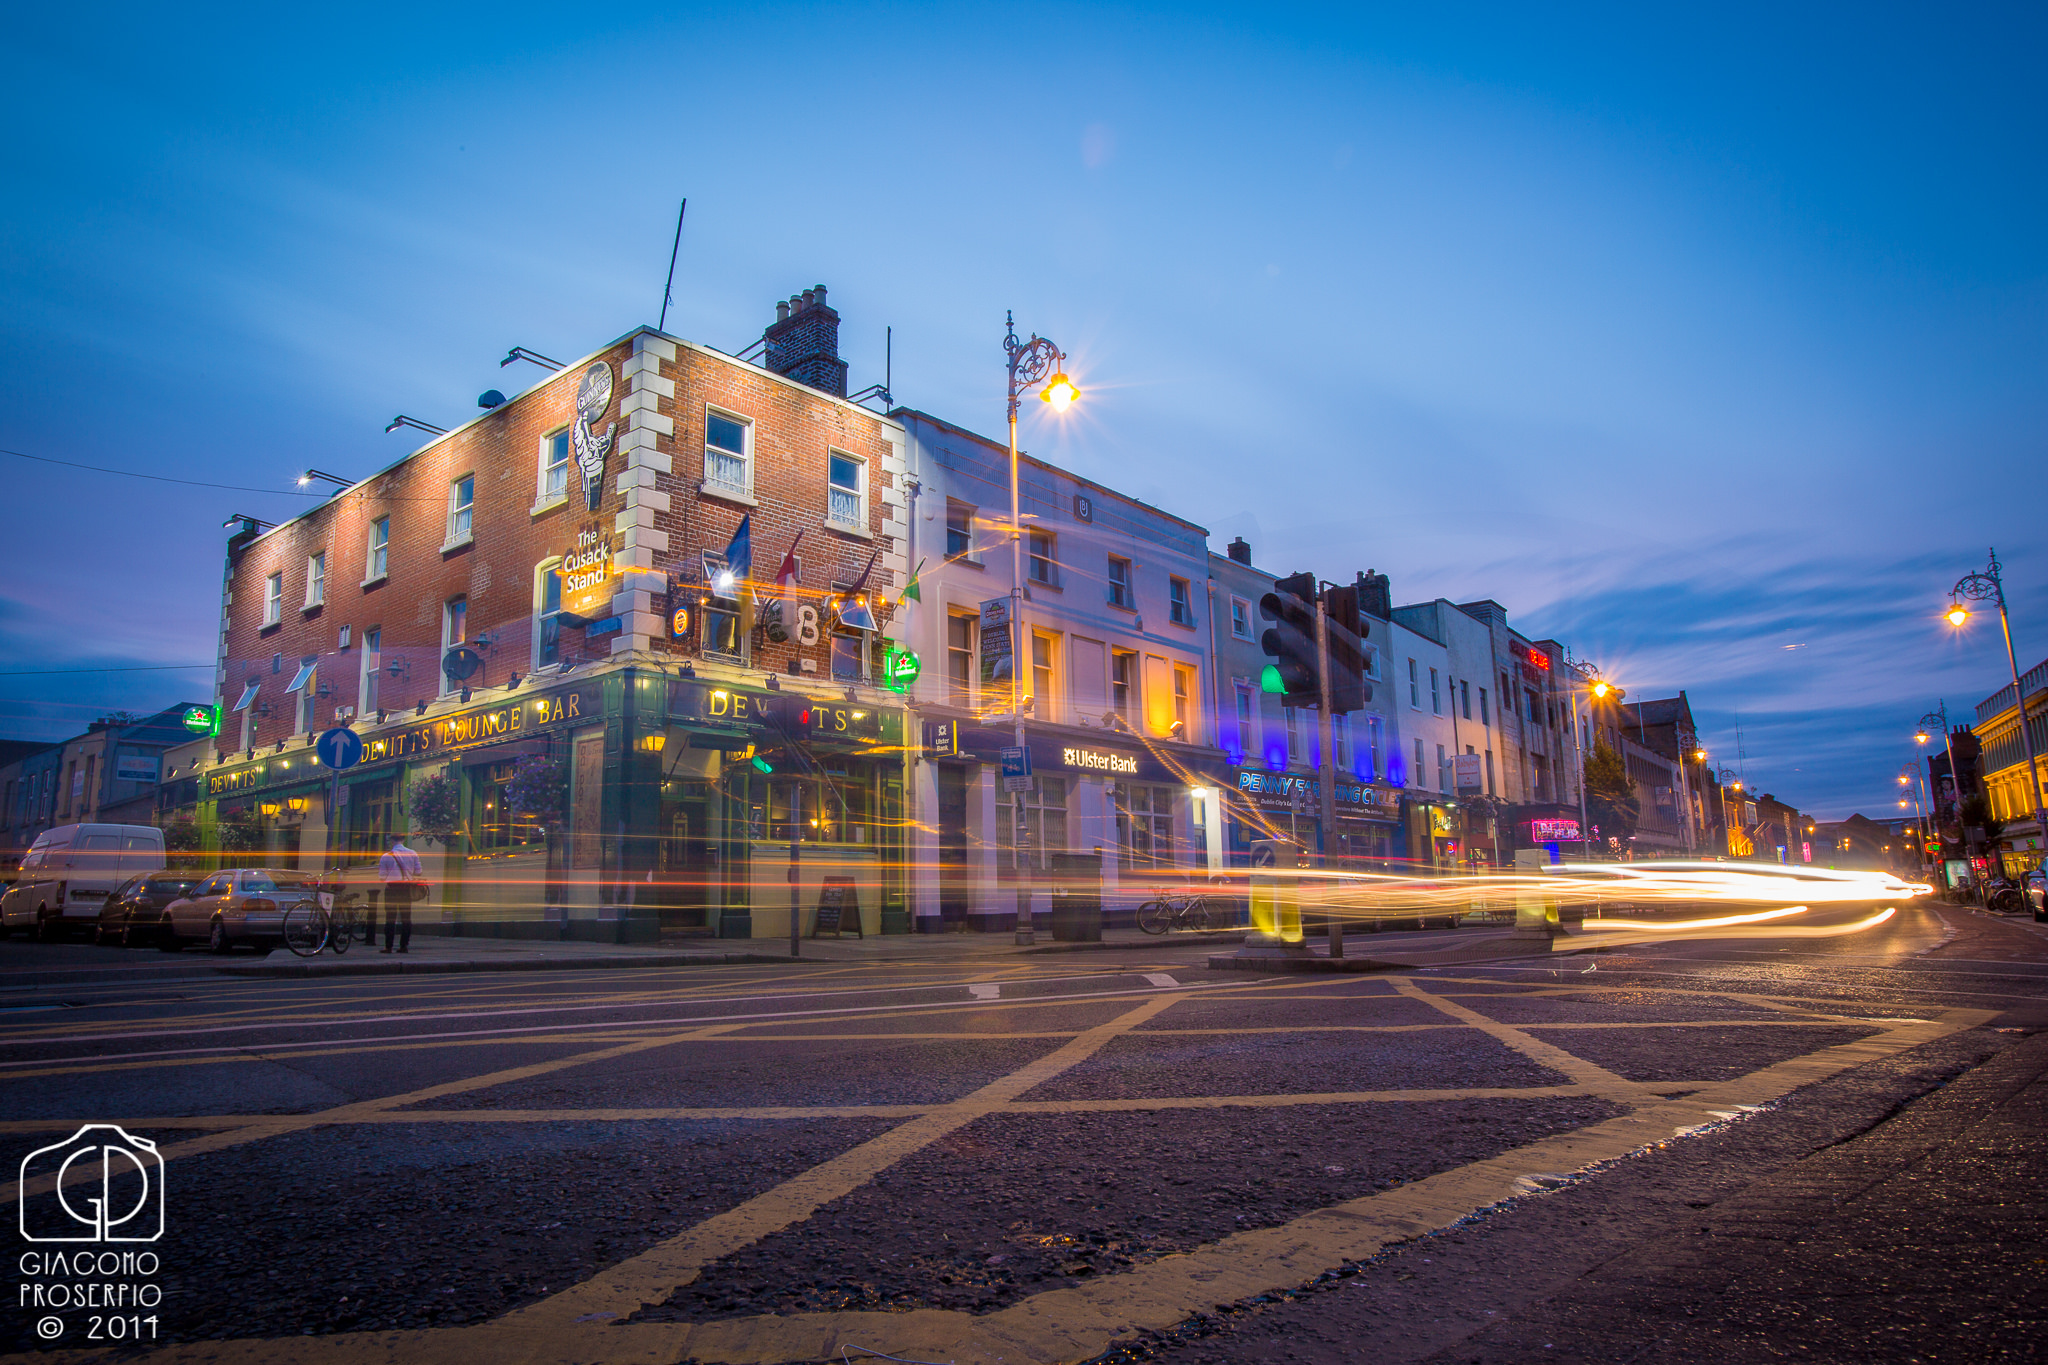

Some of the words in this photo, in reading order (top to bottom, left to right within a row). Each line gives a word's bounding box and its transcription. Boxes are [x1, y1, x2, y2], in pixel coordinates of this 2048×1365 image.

[578, 530, 598, 548] The
[564, 541, 609, 573] Cusack
[566, 563, 605, 594] Stand
[708, 690, 848, 732] DEVTS
[361, 728, 430, 763] DEVITTS
[442, 706, 521, 745] LOUNGE
[538, 693, 580, 724] BAR
[936, 744, 949, 752] Bank
[1075, 749, 1109, 770] Ulster
[1110, 753, 1138, 774] Bank
[210, 768, 256, 794] DEVITTS
[1238, 772, 1293, 796] PENNY
